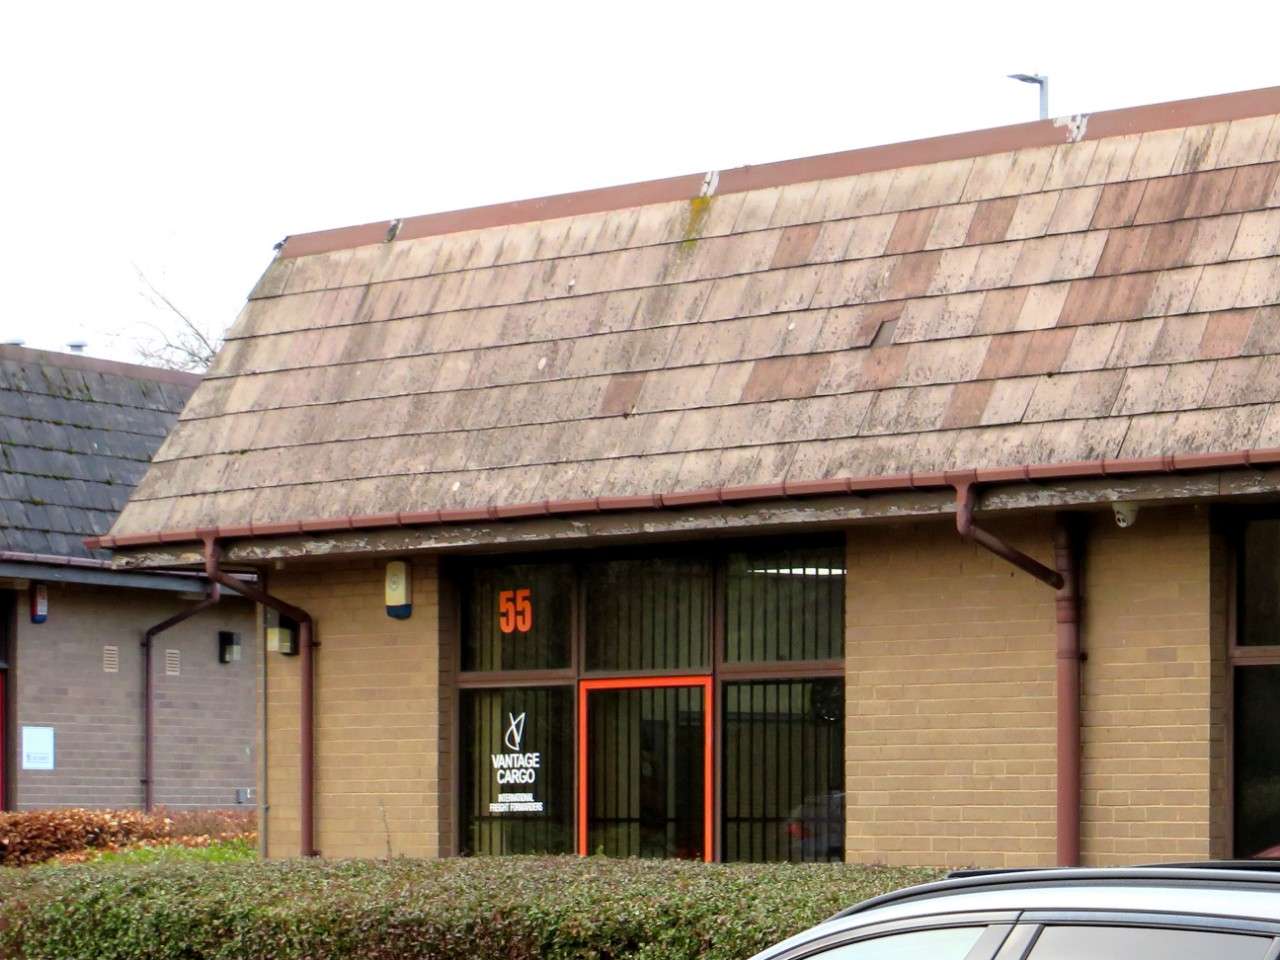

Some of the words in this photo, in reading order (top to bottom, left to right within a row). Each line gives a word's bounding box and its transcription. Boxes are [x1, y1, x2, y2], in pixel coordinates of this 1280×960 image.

[499, 588, 532, 633] 55
[491, 752, 541, 769] VANTAGE
[497, 768, 536, 784] CARGO
